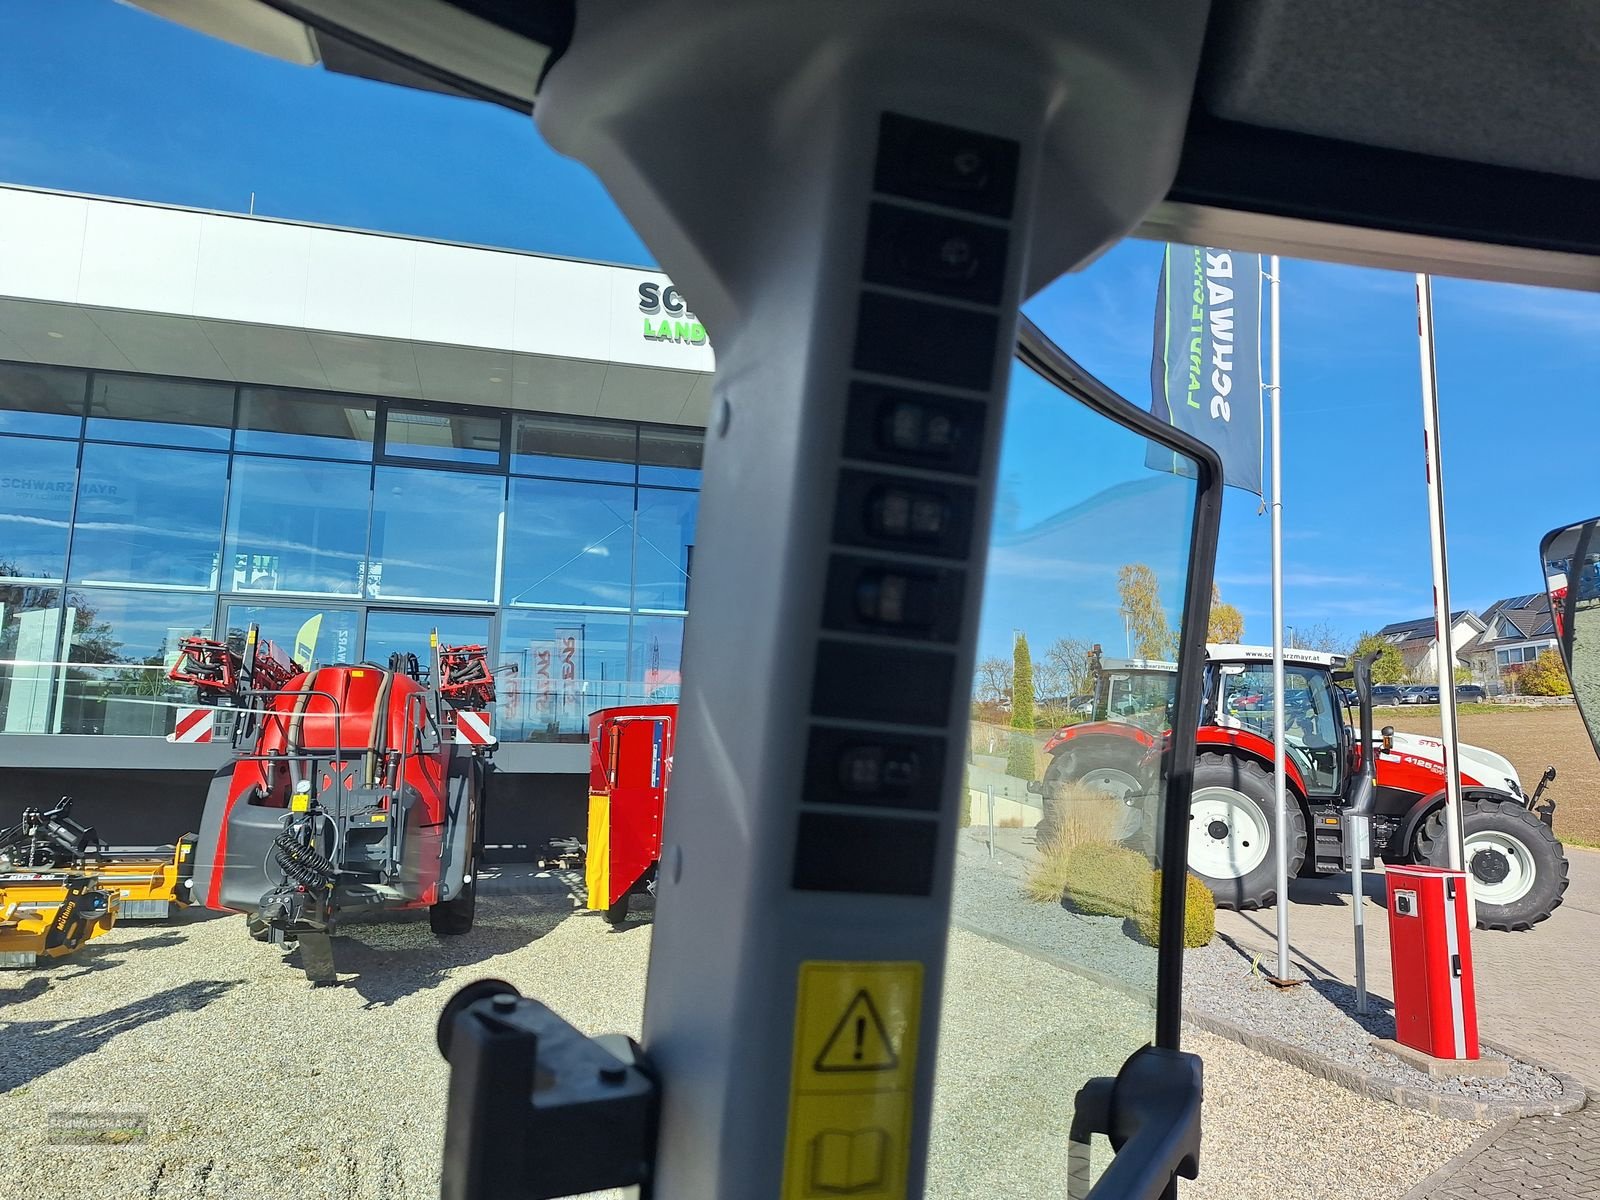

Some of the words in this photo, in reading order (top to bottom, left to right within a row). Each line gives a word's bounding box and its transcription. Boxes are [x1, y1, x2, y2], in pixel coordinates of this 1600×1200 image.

[638, 281, 685, 315] SC
[643, 318, 706, 344] LAND
[1245, 650, 1320, 662] www.scarzmayr.at
[1418, 739, 1442, 748] STEY
[1404, 756, 1432, 769] 4125
[56, 900, 76, 931] Müthing
